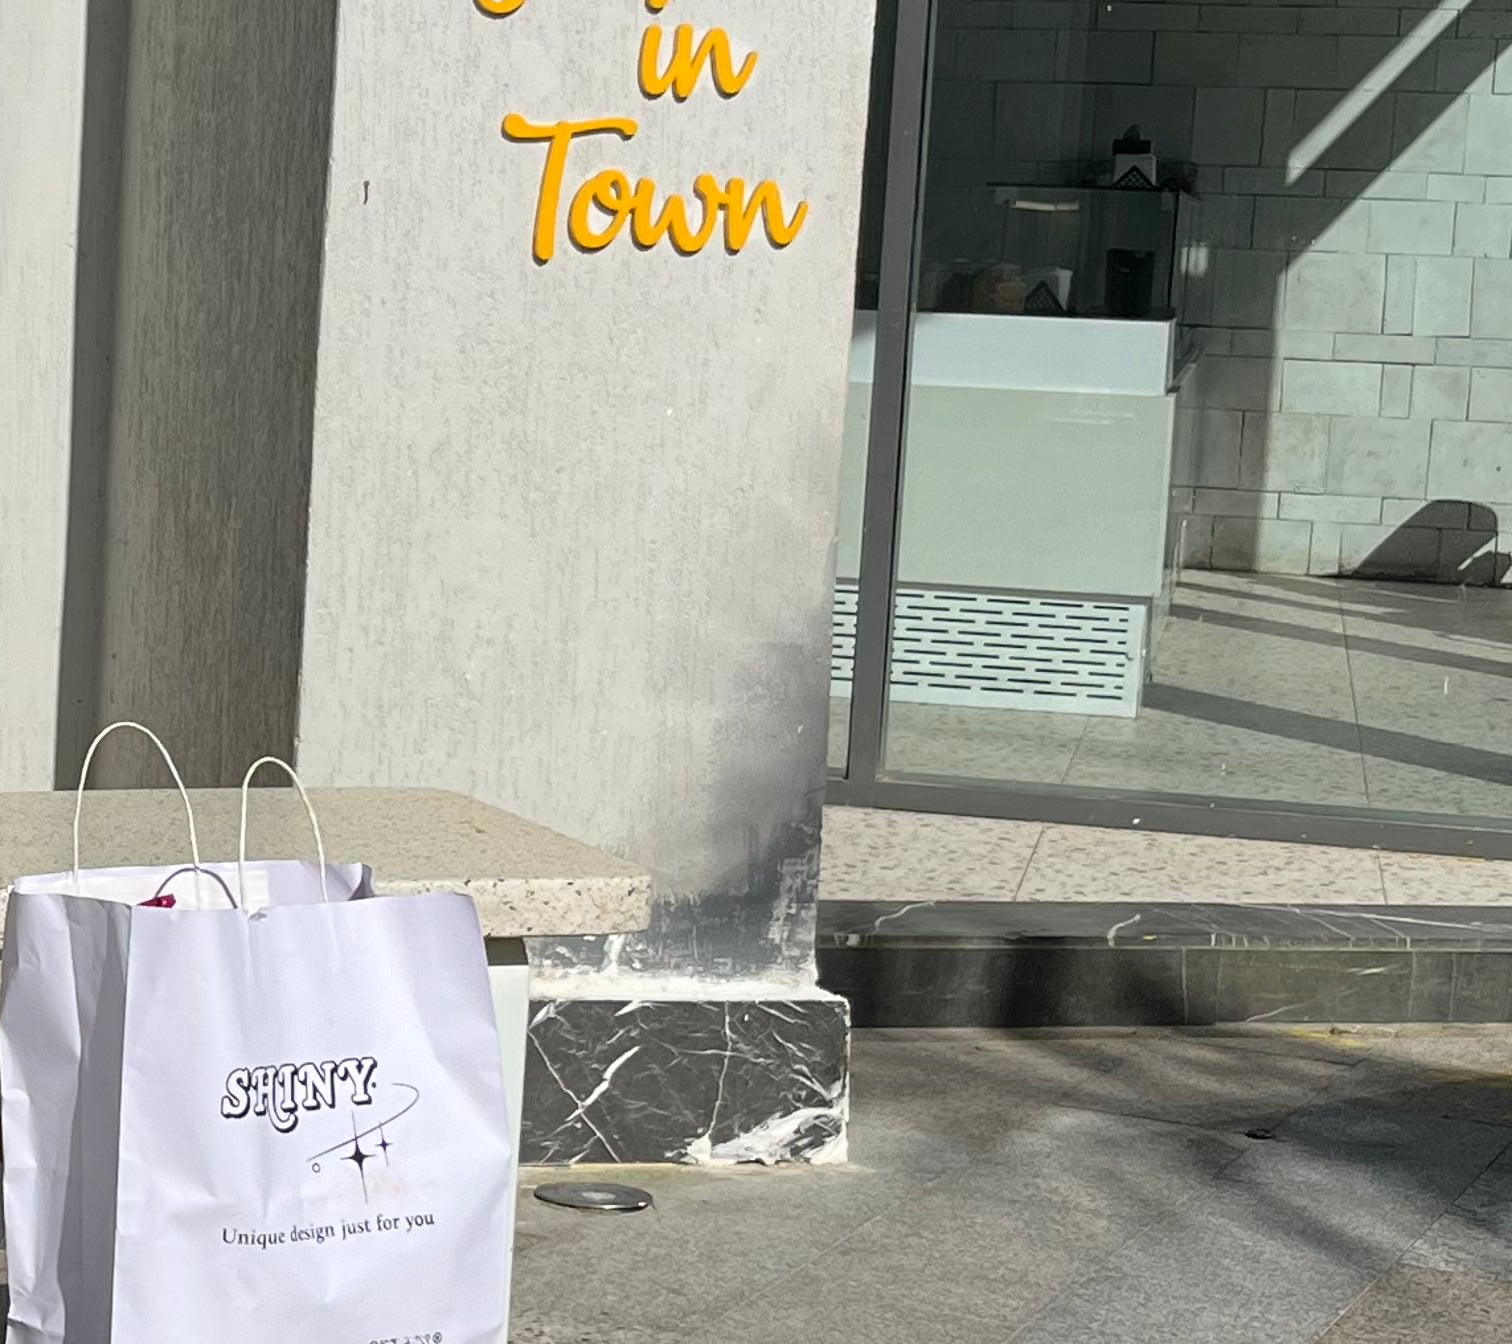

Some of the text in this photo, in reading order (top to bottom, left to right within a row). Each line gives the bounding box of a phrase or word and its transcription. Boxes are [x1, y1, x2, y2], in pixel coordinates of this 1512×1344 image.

[502, 114, 810, 263] Town
[222, 1212, 435, 1250] Unique design just for you
